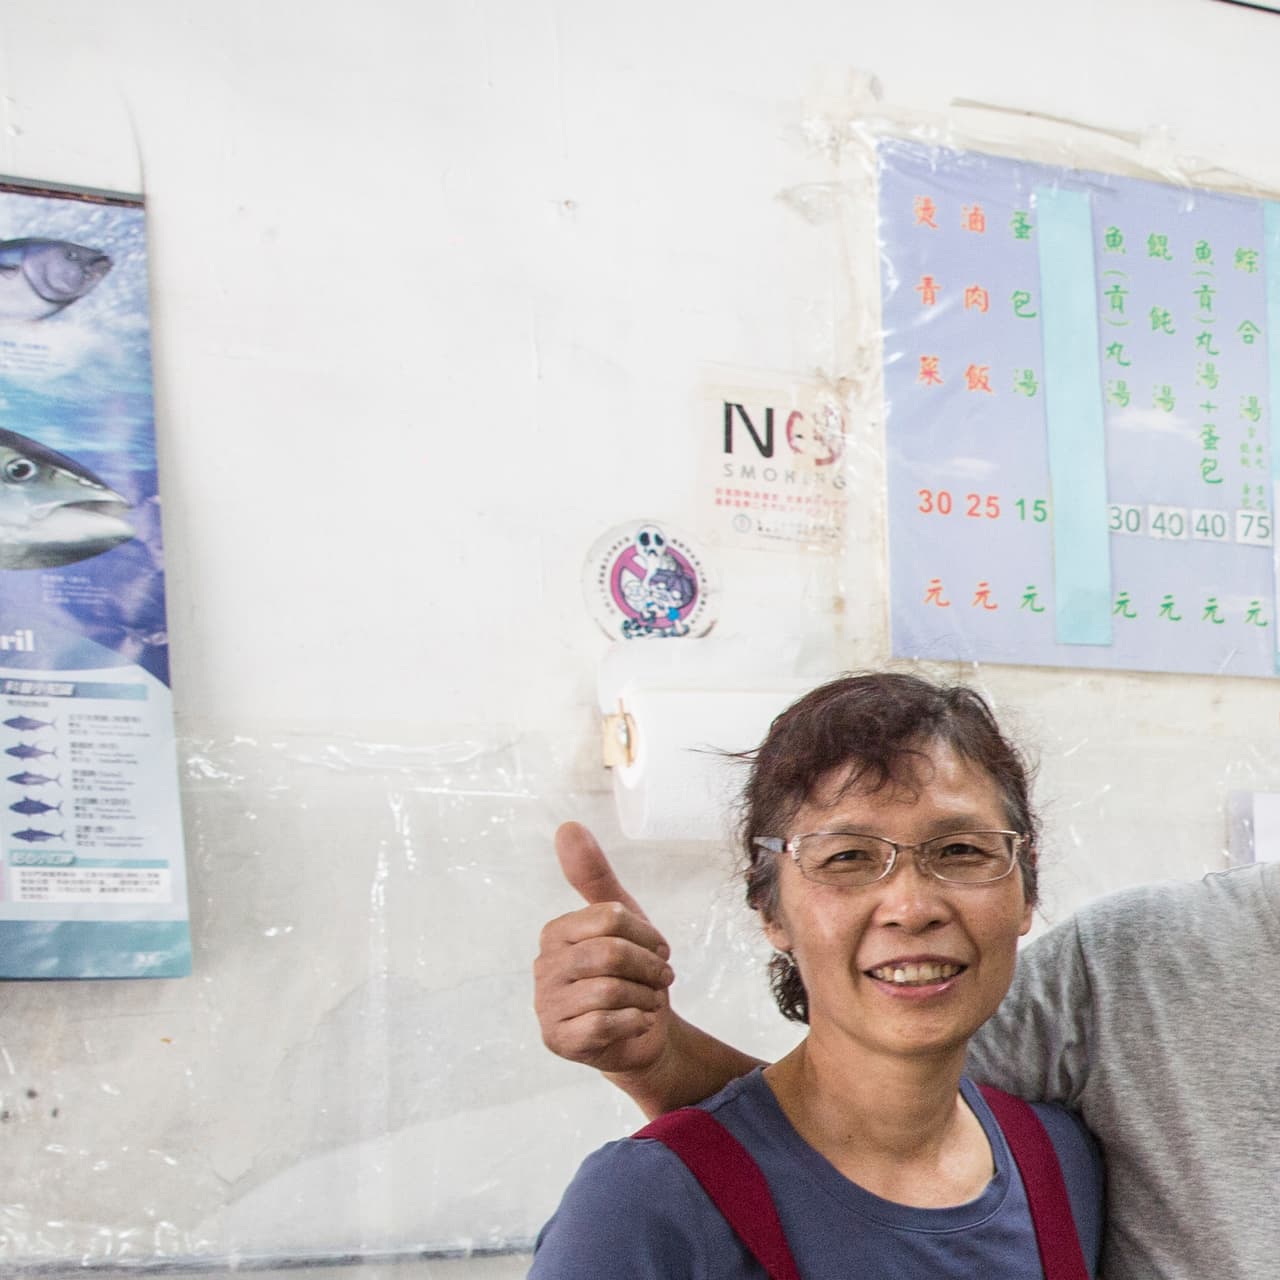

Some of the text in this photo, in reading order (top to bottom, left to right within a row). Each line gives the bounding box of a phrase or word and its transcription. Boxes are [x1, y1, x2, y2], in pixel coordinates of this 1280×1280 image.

[1010, 211, 1048, 614] 蛋包湯 15 元
[918, 489, 953, 516] 30
[966, 493, 1000, 521] 25
[1108, 507, 1142, 533] 30
[1151, 512, 1185, 538] 40
[1194, 513, 1226, 539] 40
[1240, 514, 1271, 540] 75
[924, 578, 951, 609] 元
[971, 580, 998, 611] 元
[1112, 591, 1137, 620] 元
[1158, 594, 1182, 623] 元
[1203, 597, 1225, 625] 元
[1244, 601, 1270, 628] 元
